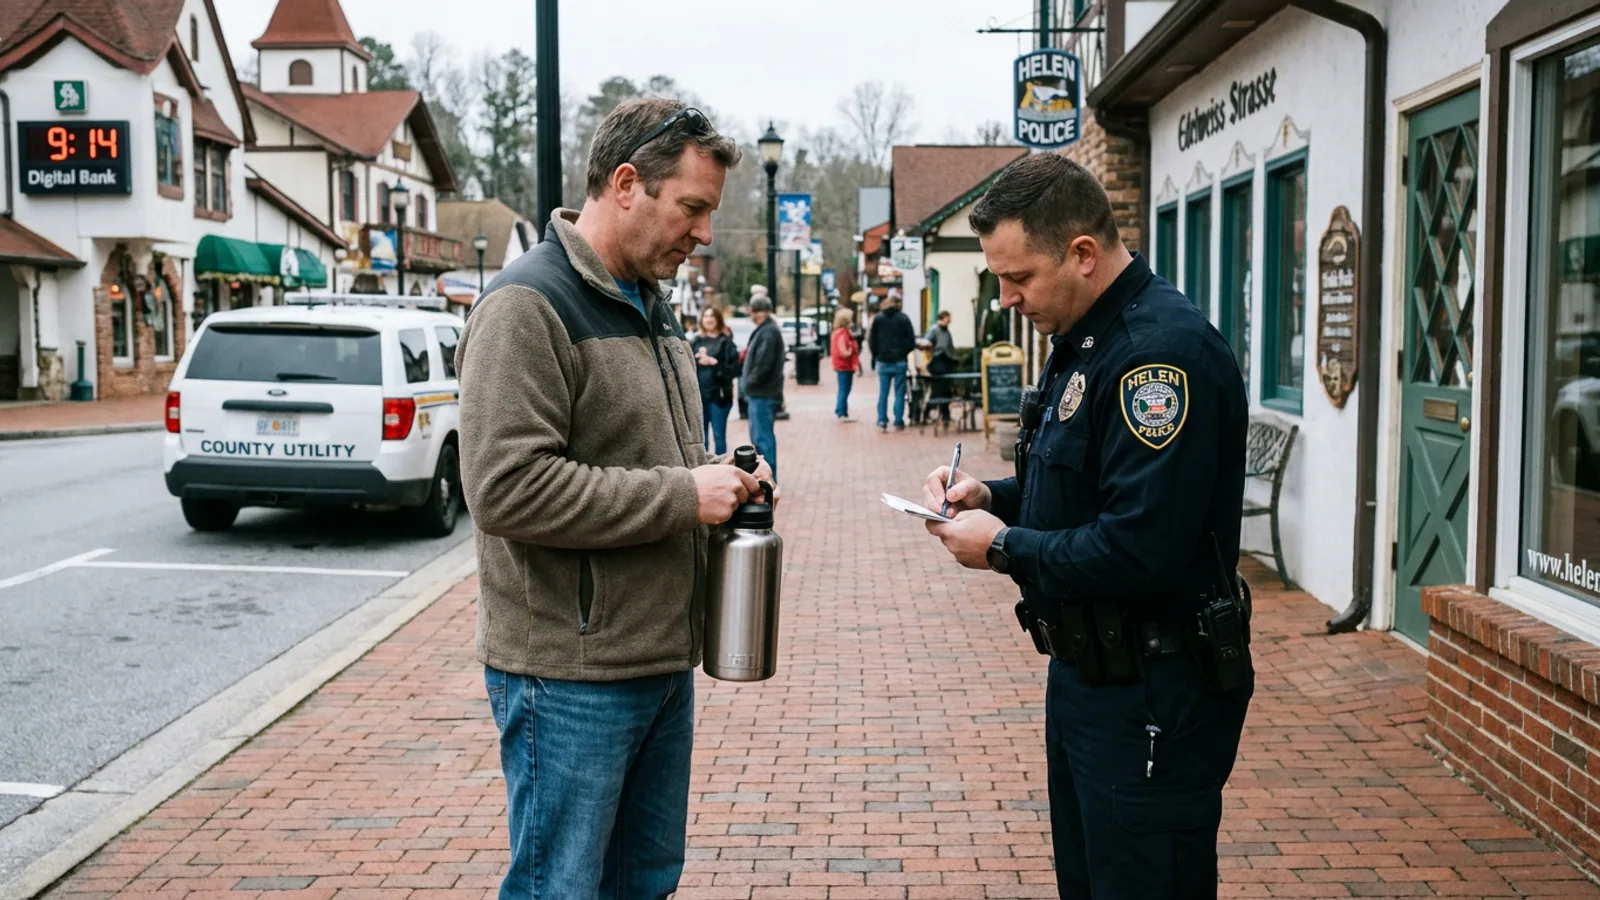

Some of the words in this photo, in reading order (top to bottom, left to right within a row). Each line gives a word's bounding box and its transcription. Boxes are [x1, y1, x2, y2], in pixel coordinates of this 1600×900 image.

[1018, 54, 1076, 83] HELEN
[1229, 66, 1277, 125] Strasse
[1017, 119, 1076, 144] POLICE
[28, 169, 76, 189] Digital
[79, 168, 117, 185] Bank
[1127, 369, 1180, 391] HELEN
[200, 439, 275, 456] COUNTY
[283, 443, 356, 458] UTILITY
